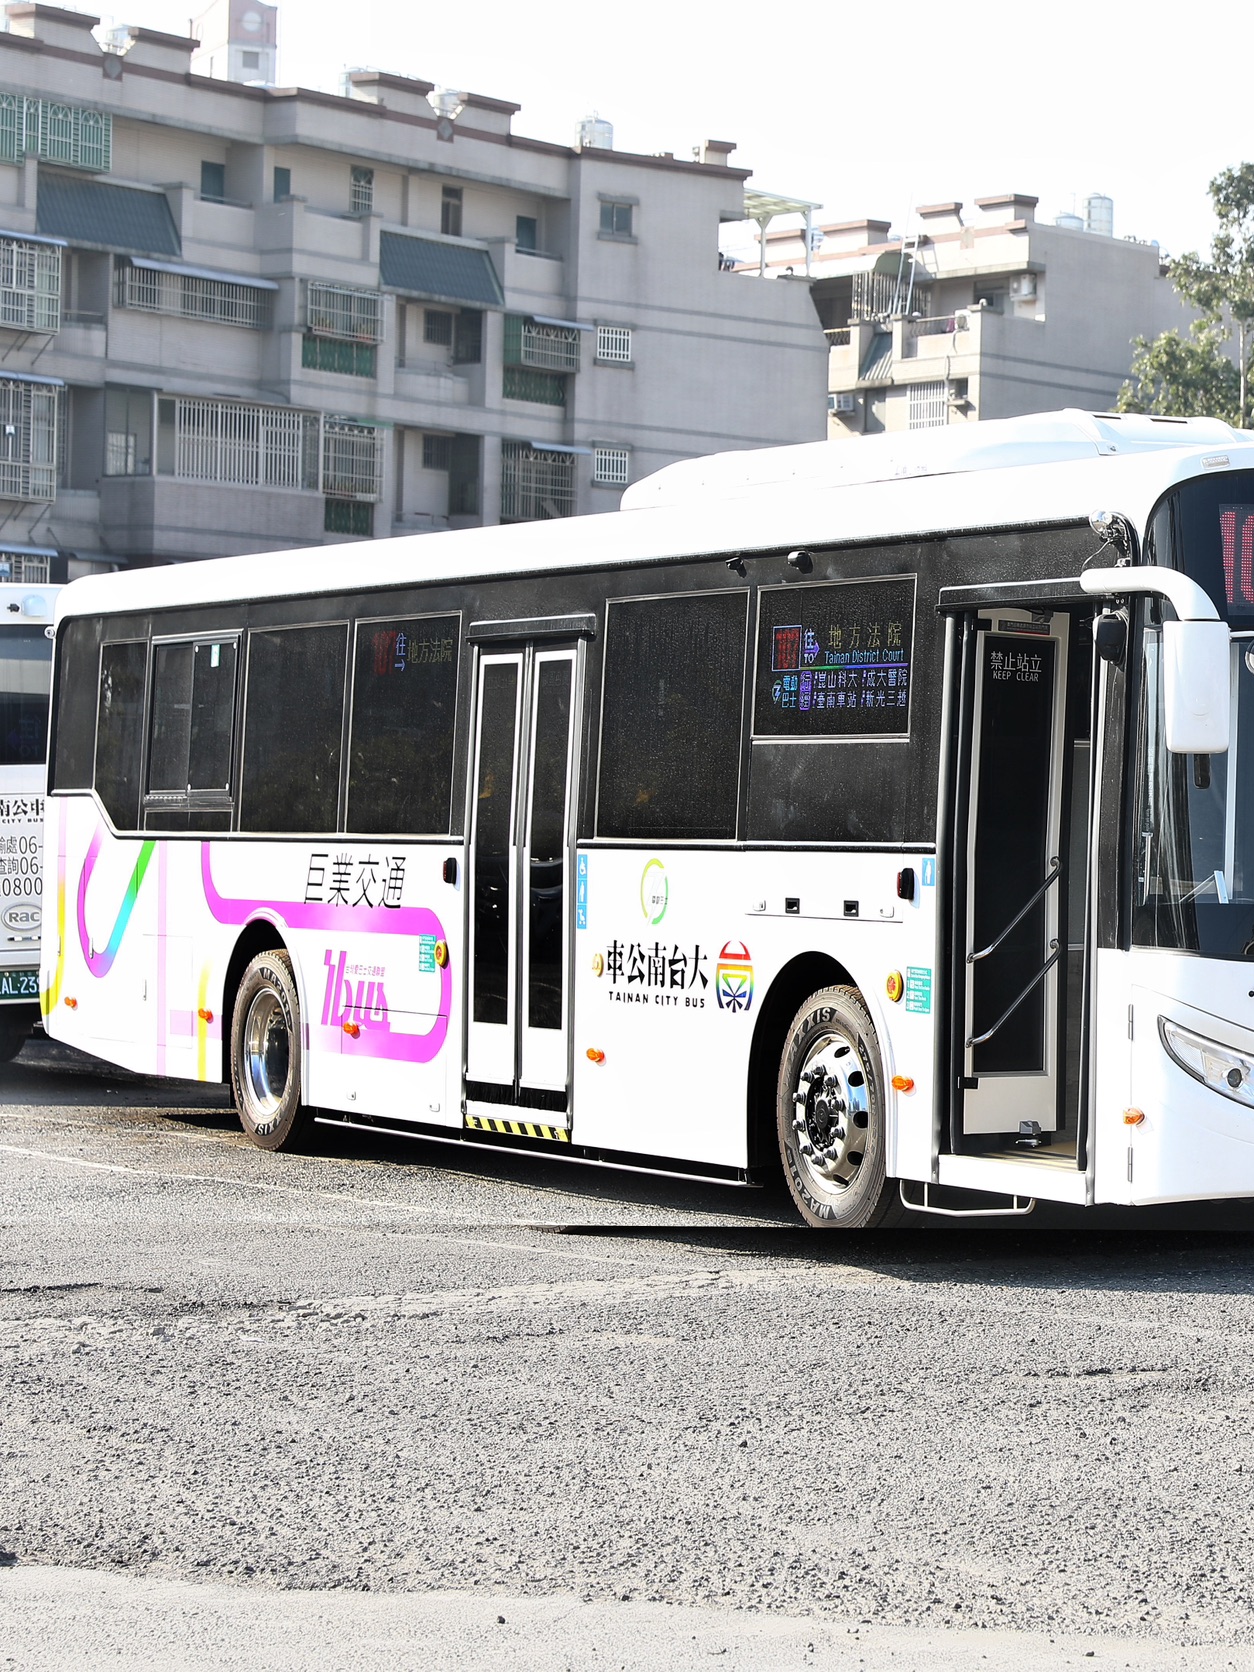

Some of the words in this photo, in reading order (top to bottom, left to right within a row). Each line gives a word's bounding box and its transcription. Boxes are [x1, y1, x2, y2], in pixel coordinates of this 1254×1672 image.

[828, 621, 903, 649] 地方法院
[407, 636, 453, 664] 地方法院
[803, 653, 815, 664] TO
[825, 651, 849, 665] Tainan
[852, 650, 880, 663] District
[882, 648, 904, 662] Court
[990, 651, 1042, 673] 禁止站立
[866, 668, 908, 688] 成大醫院
[992, 670, 1012, 680] KEEP
[1016, 672, 1039, 682] CLEAR
[781, 692, 797, 708] 巴士
[865, 689, 907, 708] 新光三越
[304, 852, 406, 909] 巨業交通
[608, 991, 649, 1005] TAINAN
[655, 994, 678, 1006] CITY
[685, 997, 705, 1009] BUS
